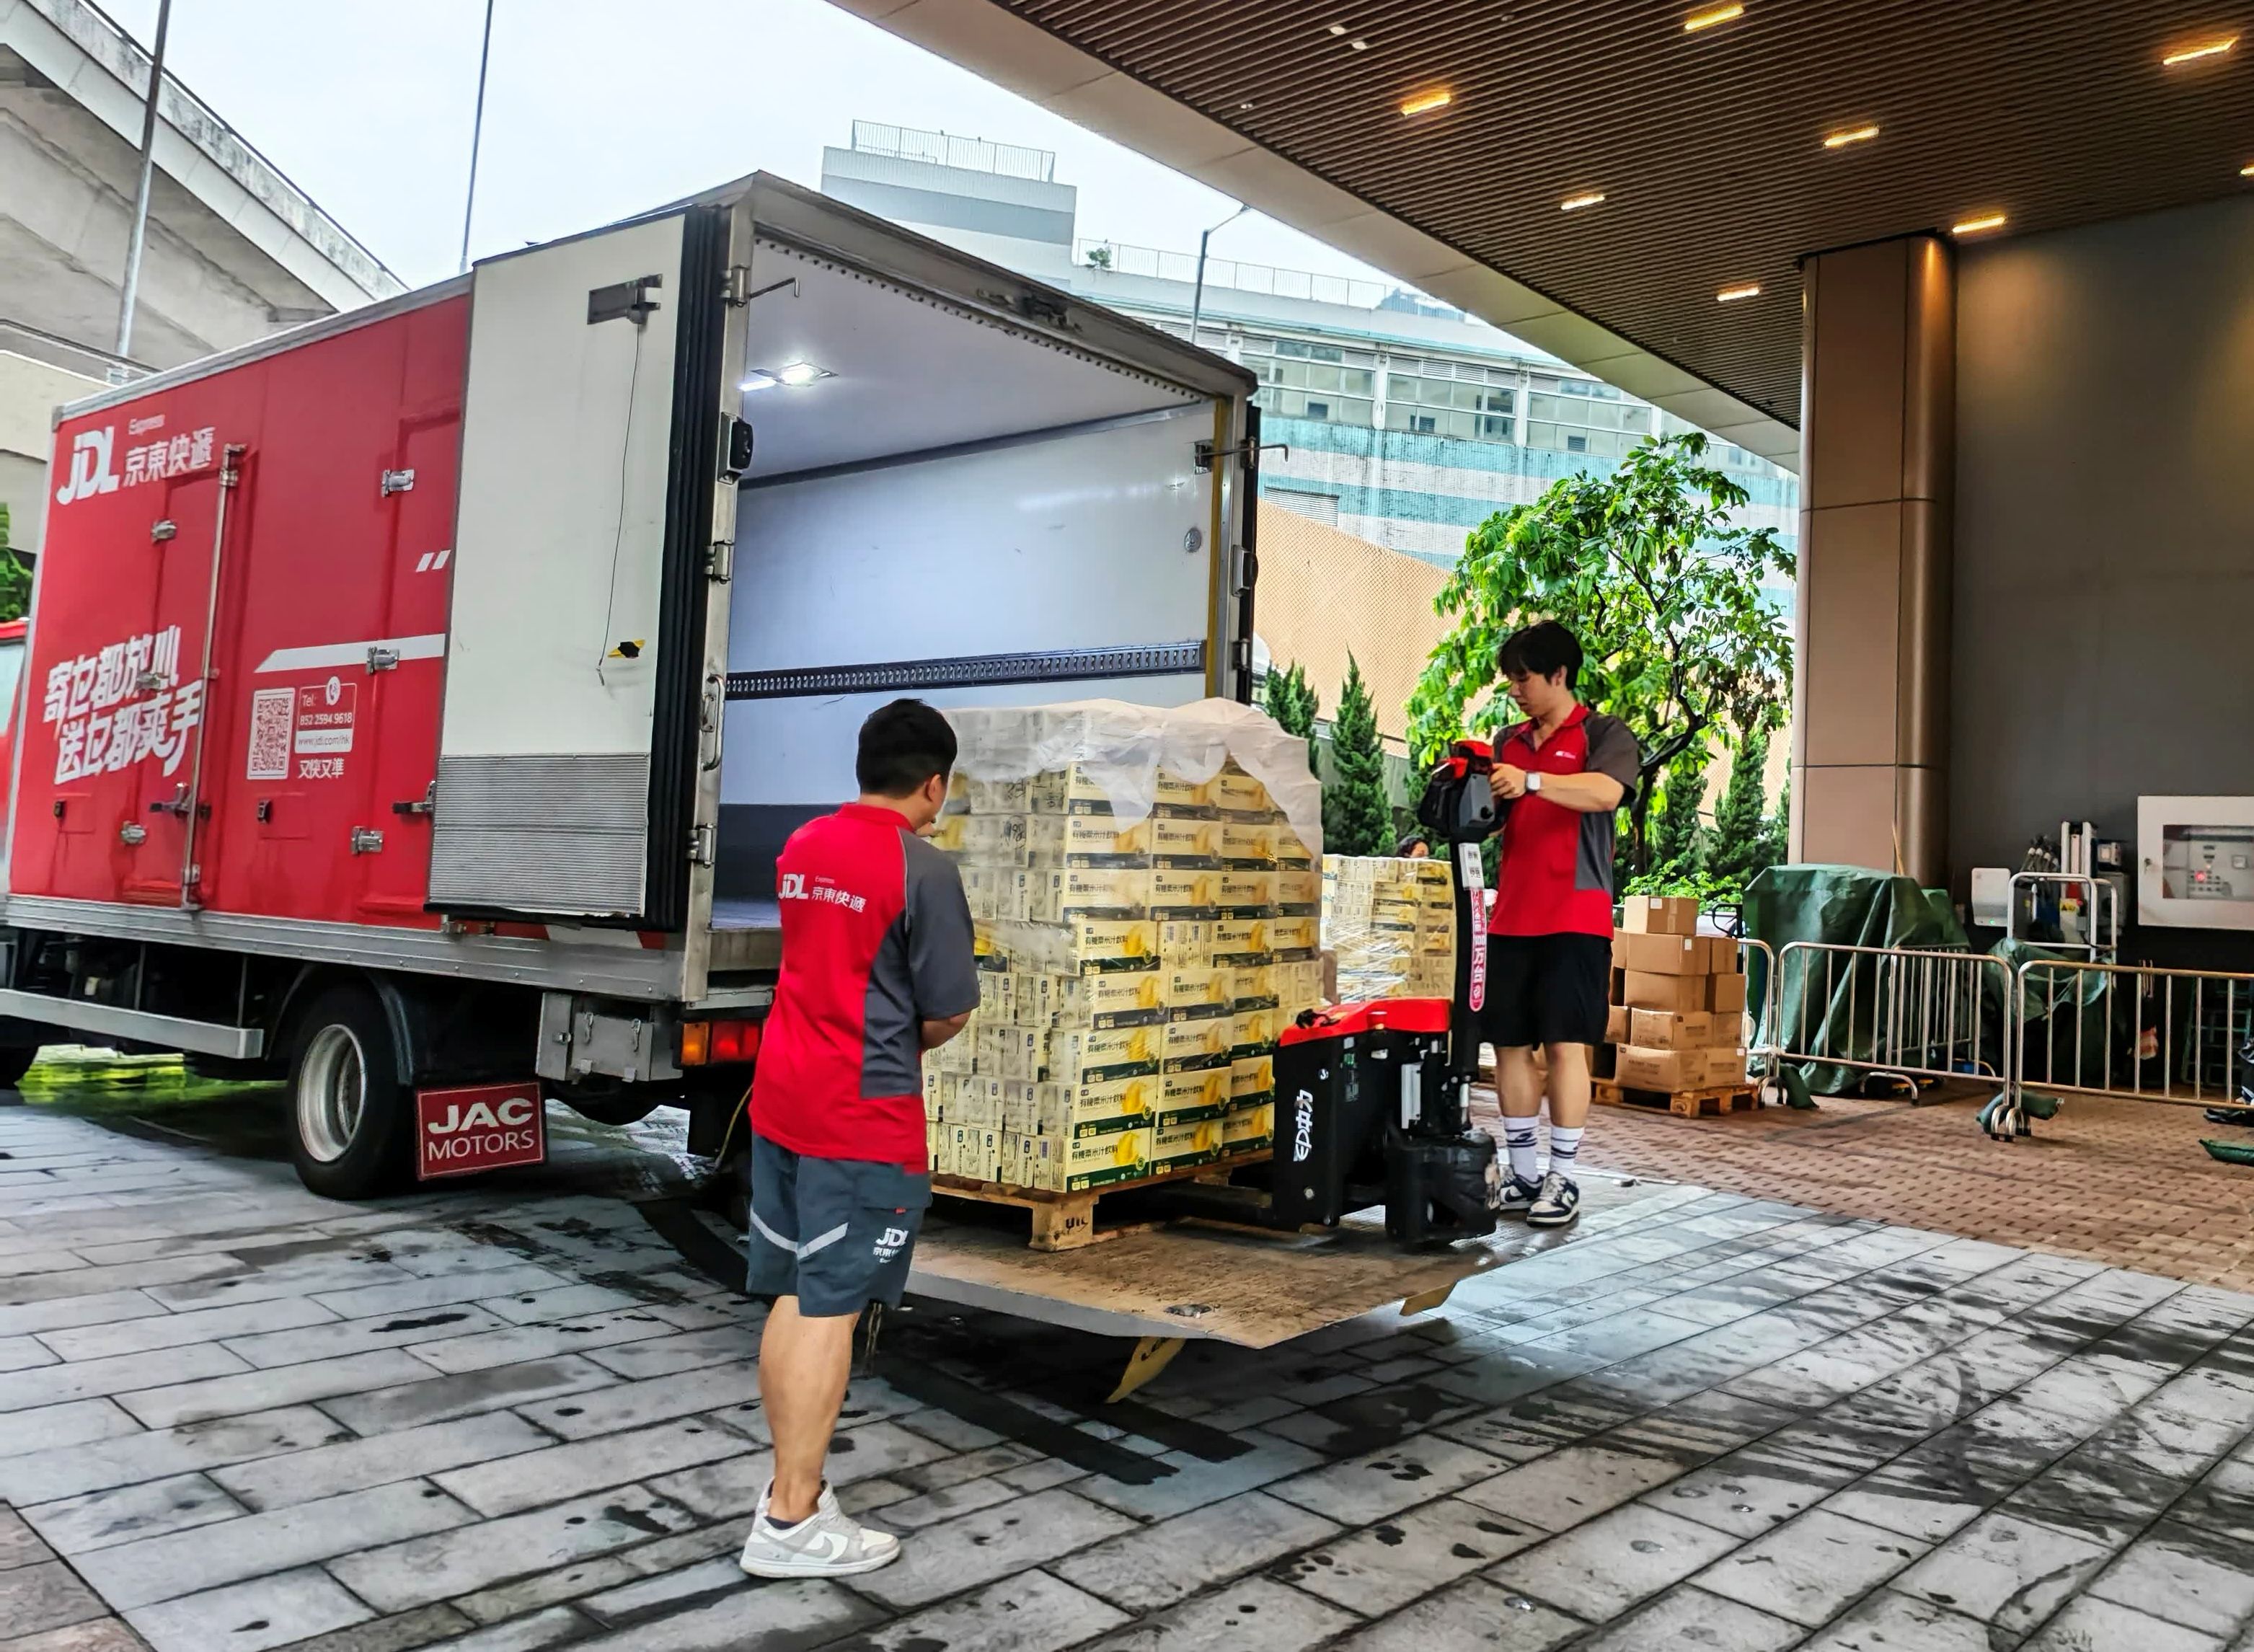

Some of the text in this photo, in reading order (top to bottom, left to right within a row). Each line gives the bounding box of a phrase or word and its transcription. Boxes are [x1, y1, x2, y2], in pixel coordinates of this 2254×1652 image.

[56, 426, 120, 505] JDL
[302, 694, 317, 707] Tel:
[300, 715, 313, 725] 852
[335, 712, 353, 724] 9618
[298, 735, 350, 747] www.jdl.com/hk
[778, 873, 809, 900] JDL
[812, 885, 867, 913] 京東快遞
[428, 1097, 534, 1134] JAC
[428, 1129, 534, 1162] MOTORS
